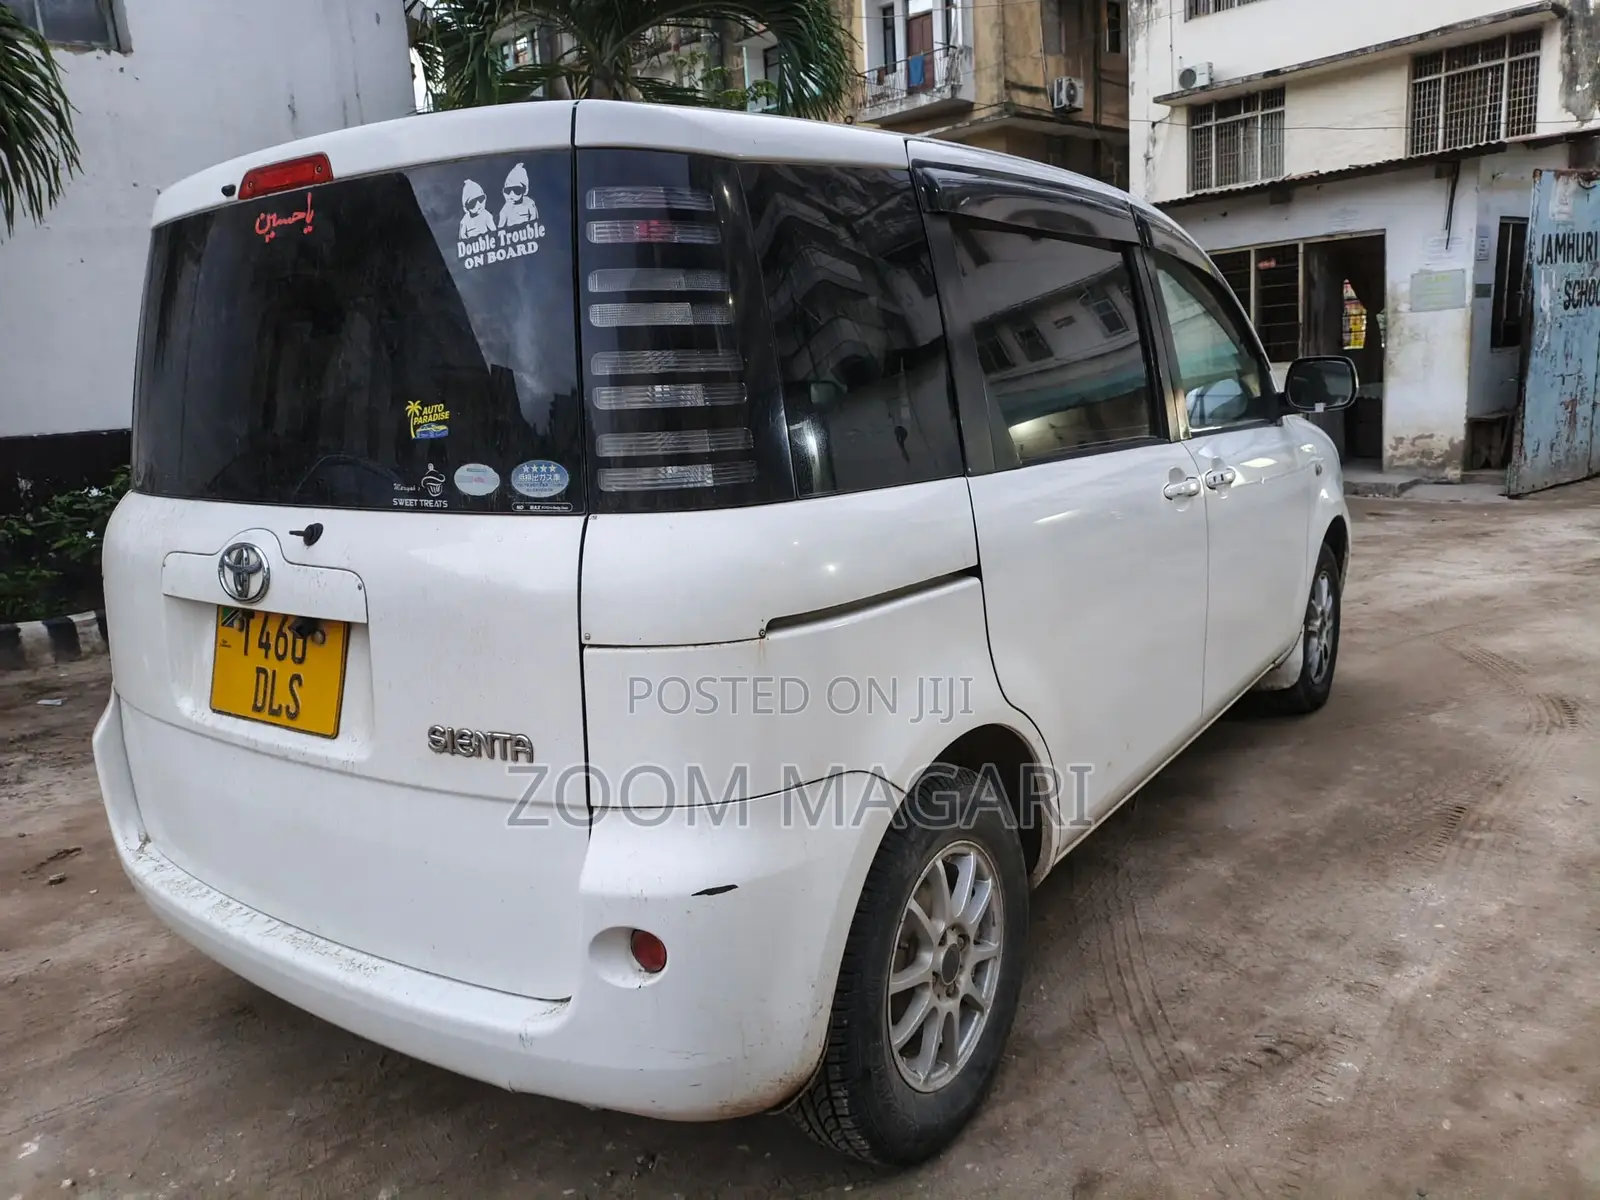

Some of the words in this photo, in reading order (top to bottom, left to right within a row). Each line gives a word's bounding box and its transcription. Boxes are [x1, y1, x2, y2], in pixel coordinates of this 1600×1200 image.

[457, 234, 496, 258] Double
[498, 222, 546, 247] Trouble
[464, 254, 484, 270] ON
[487, 241, 539, 264] BOARD
[1536, 231, 1598, 266] JAMHURI
[413, 411, 450, 425] PARADISE
[422, 403, 444, 416] AUTO
[392, 497, 418, 507] SWEET
[419, 499, 448, 508] TREATS
[252, 666, 303, 721] DLS
[427, 724, 534, 763] SIENTA
